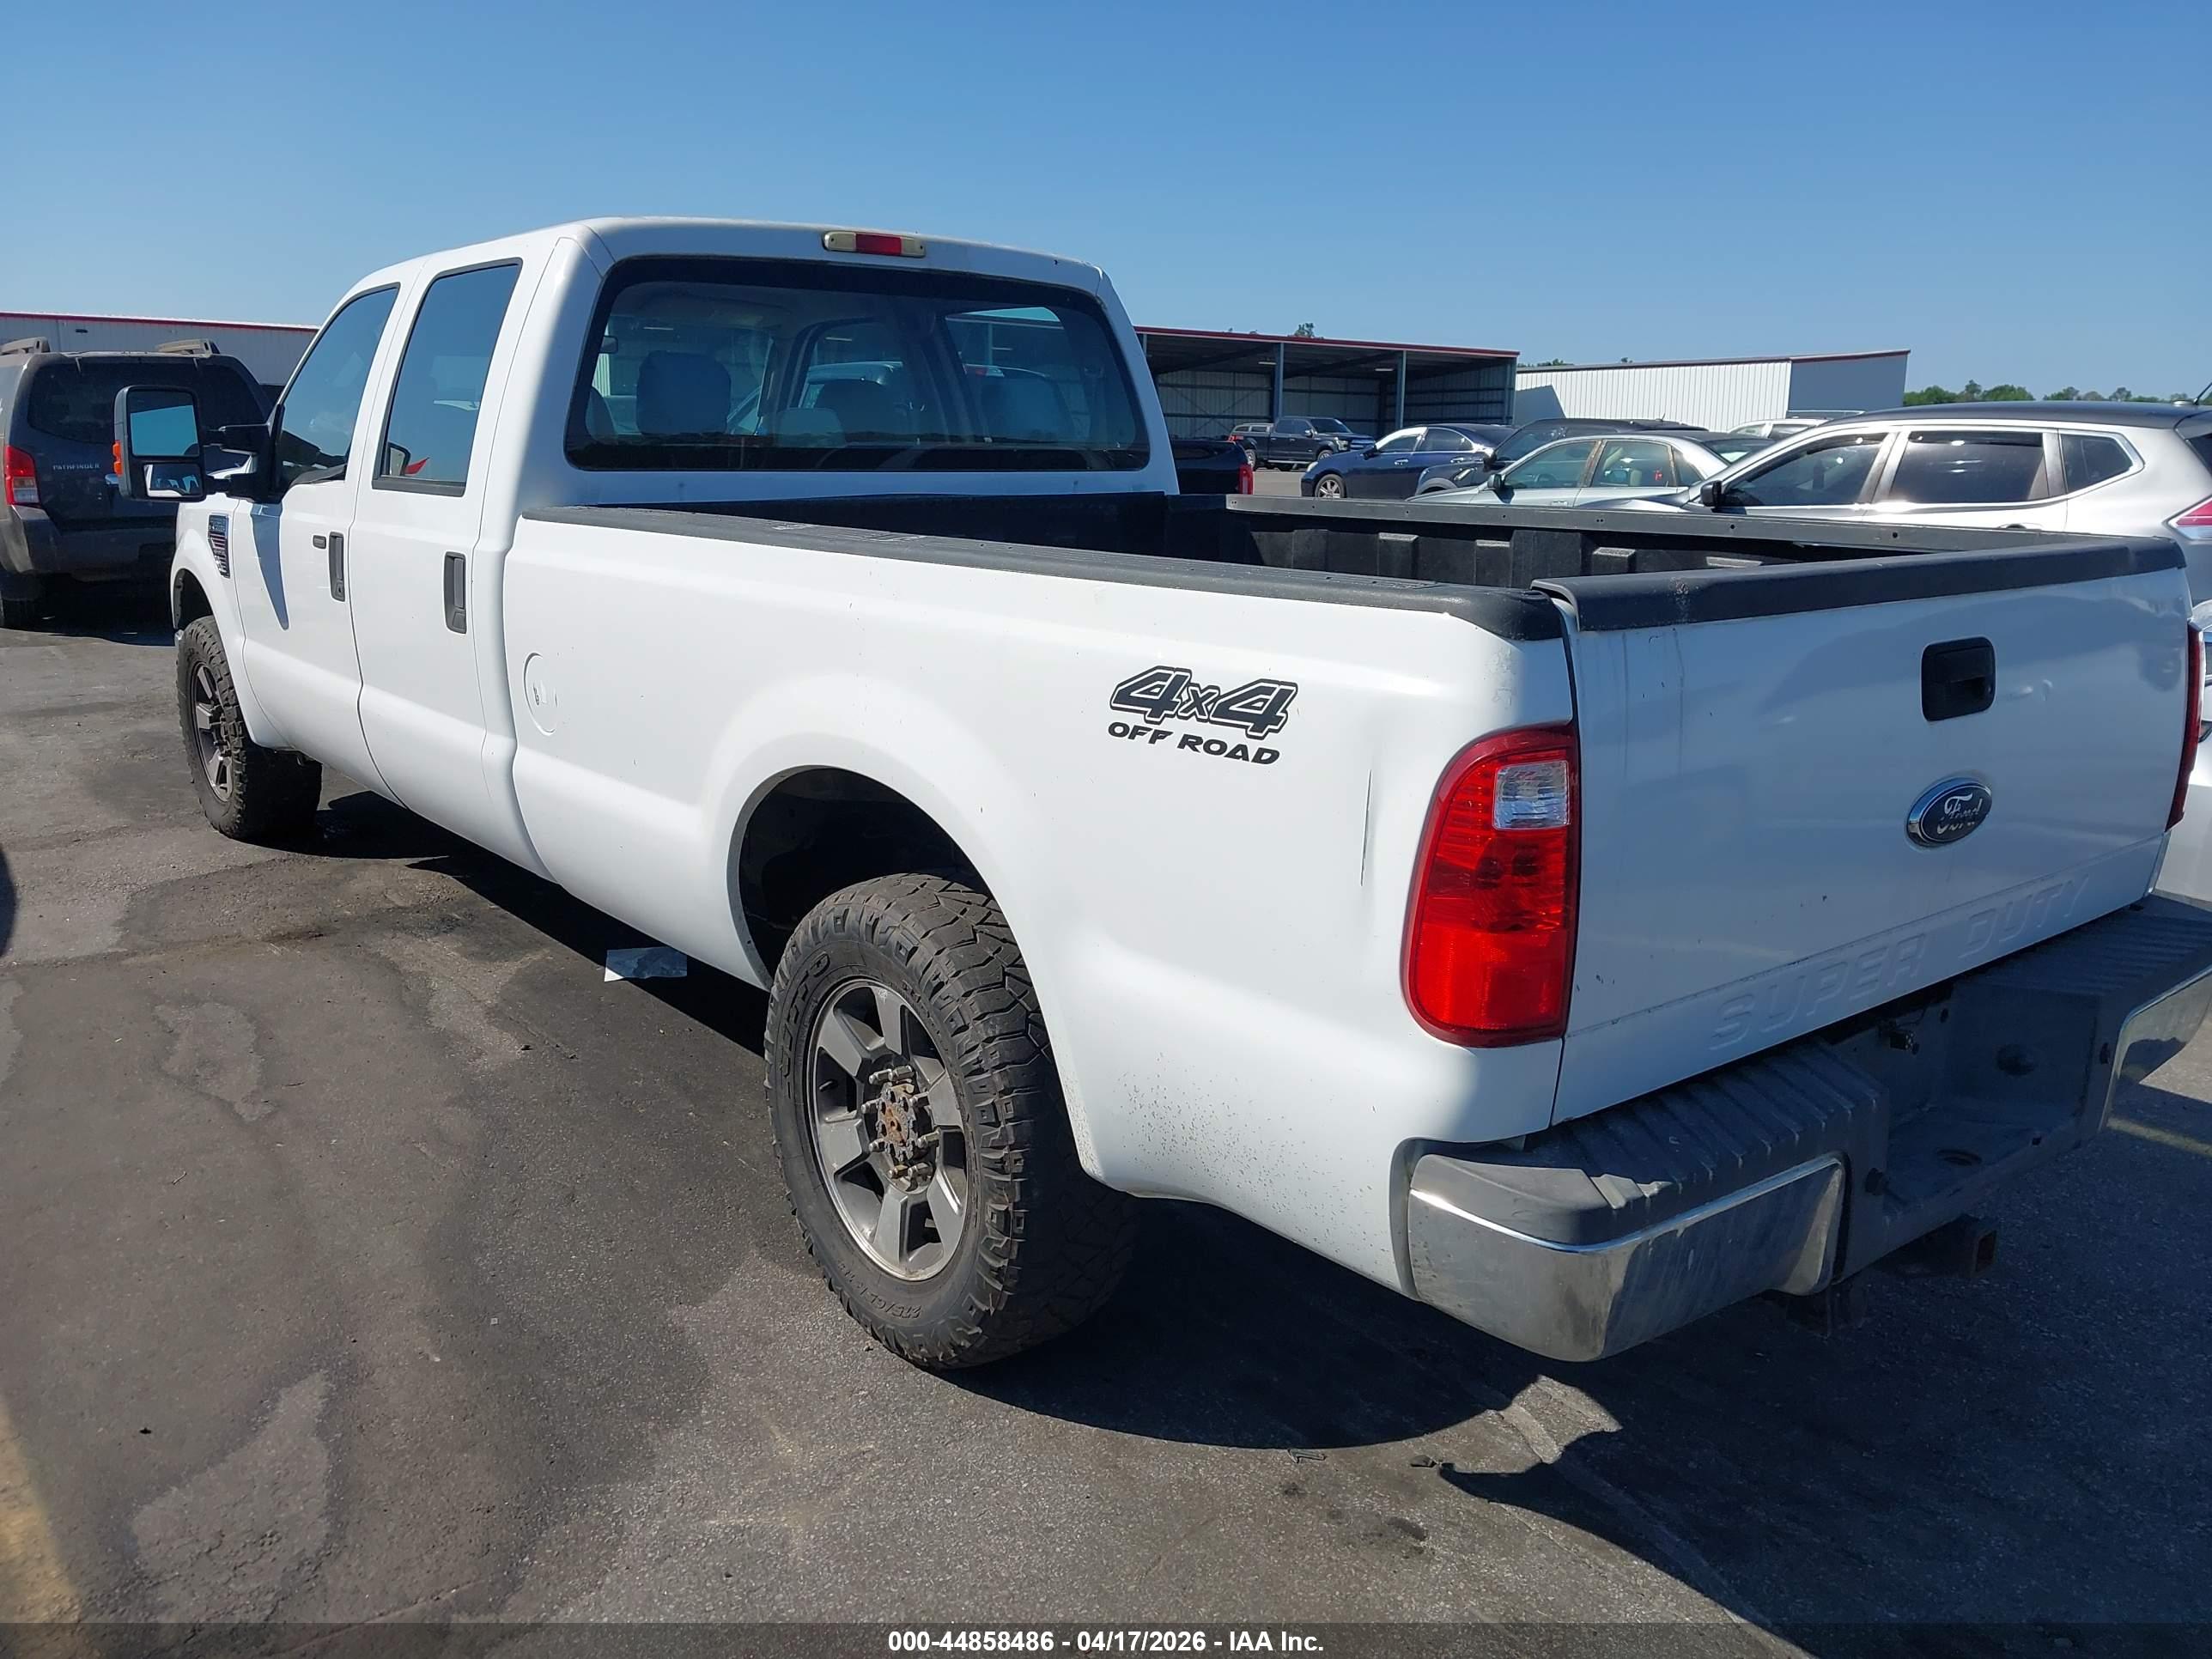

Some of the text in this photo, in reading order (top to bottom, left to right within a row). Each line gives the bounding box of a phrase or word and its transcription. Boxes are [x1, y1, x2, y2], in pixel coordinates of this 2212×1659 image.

[1108, 721, 1280, 765] OFF ROAD
[1708, 872, 2091, 1051] SUPER DUTY
